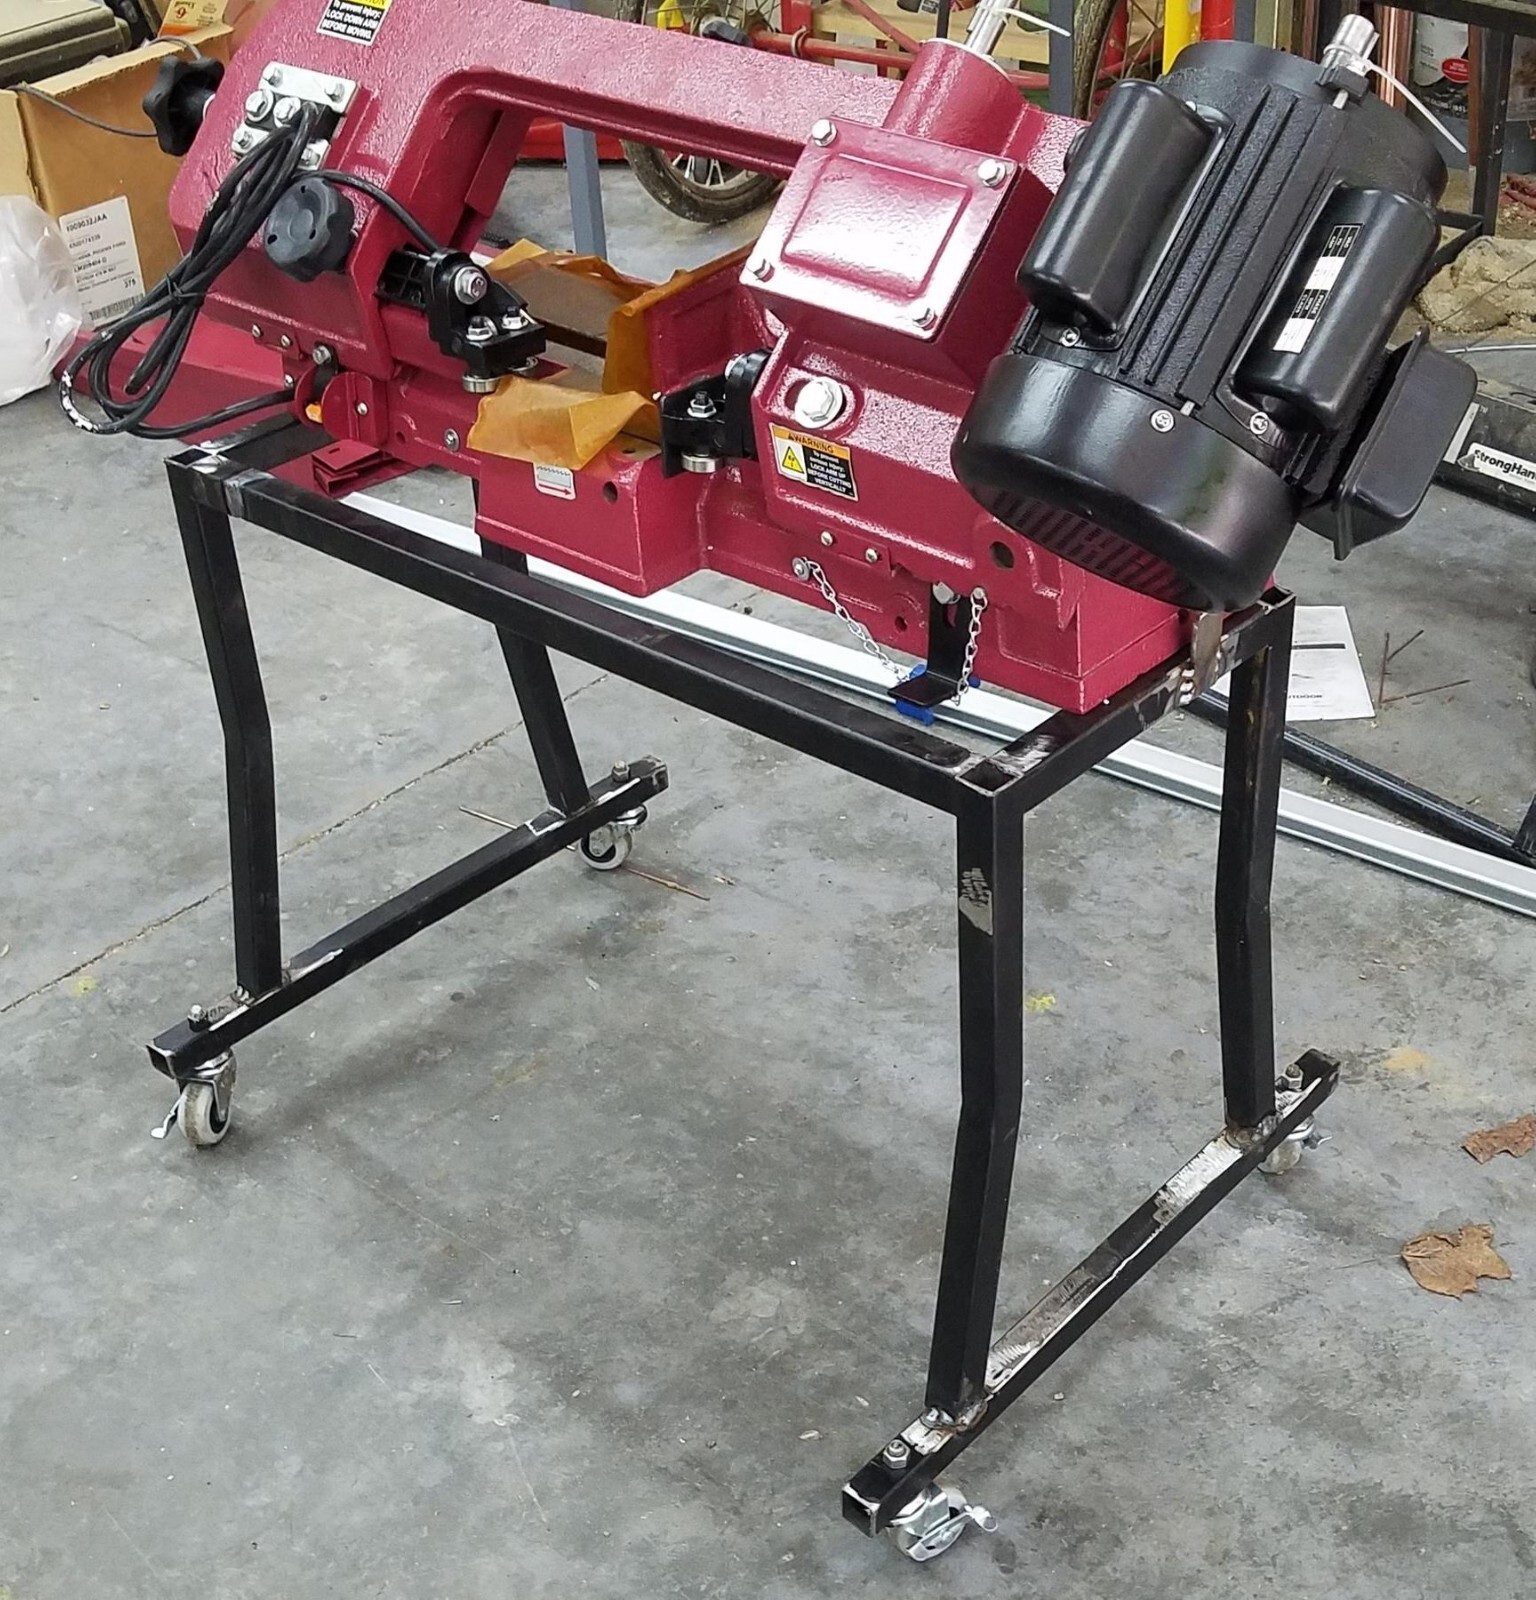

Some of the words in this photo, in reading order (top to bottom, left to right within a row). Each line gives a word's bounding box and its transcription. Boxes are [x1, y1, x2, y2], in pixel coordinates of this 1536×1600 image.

[322, 19, 347, 33] BEFORE
[326, 9, 343, 22] LOCK
[344, 14, 363, 26] DOWN
[363, 18, 379, 29] ARM
[794, 435, 835, 454] WARNING
[810, 463, 825, 474] LOCK
[825, 468, 838, 477] ARM
[838, 471, 847, 479] UP
[1474, 448, 1536, 480] StrongHan
[807, 469, 829, 480] BEFORE
[829, 475, 852, 489] CUTTING
[814, 477, 847, 492] VERTICALLY
